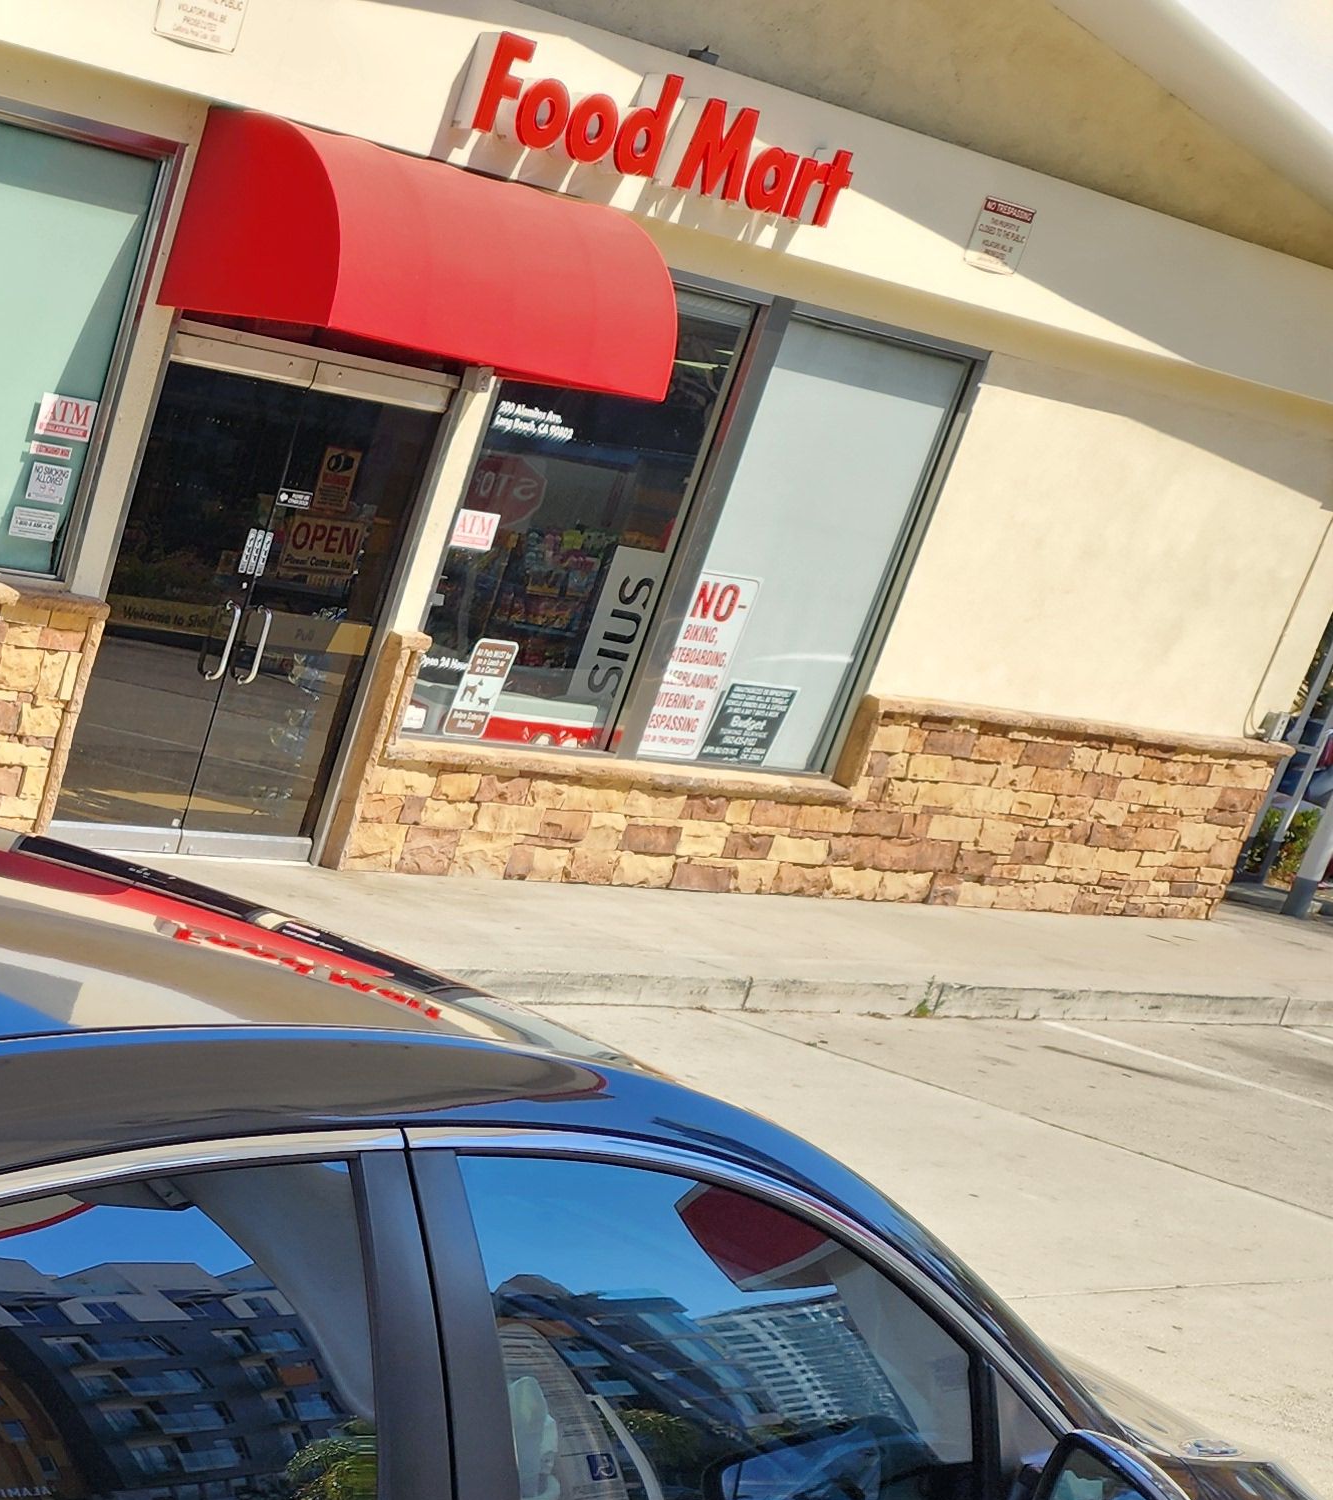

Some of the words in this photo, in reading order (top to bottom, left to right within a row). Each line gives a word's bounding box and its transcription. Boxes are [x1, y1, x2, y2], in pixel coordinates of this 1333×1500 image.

[471, 31, 684, 178] Food
[672, 98, 854, 228] Mart
[44, 400, 92, 426] ATM
[457, 513, 495, 537] ATM
[292, 521, 359, 556] OPEN
[730, 715, 767, 731] Budget
